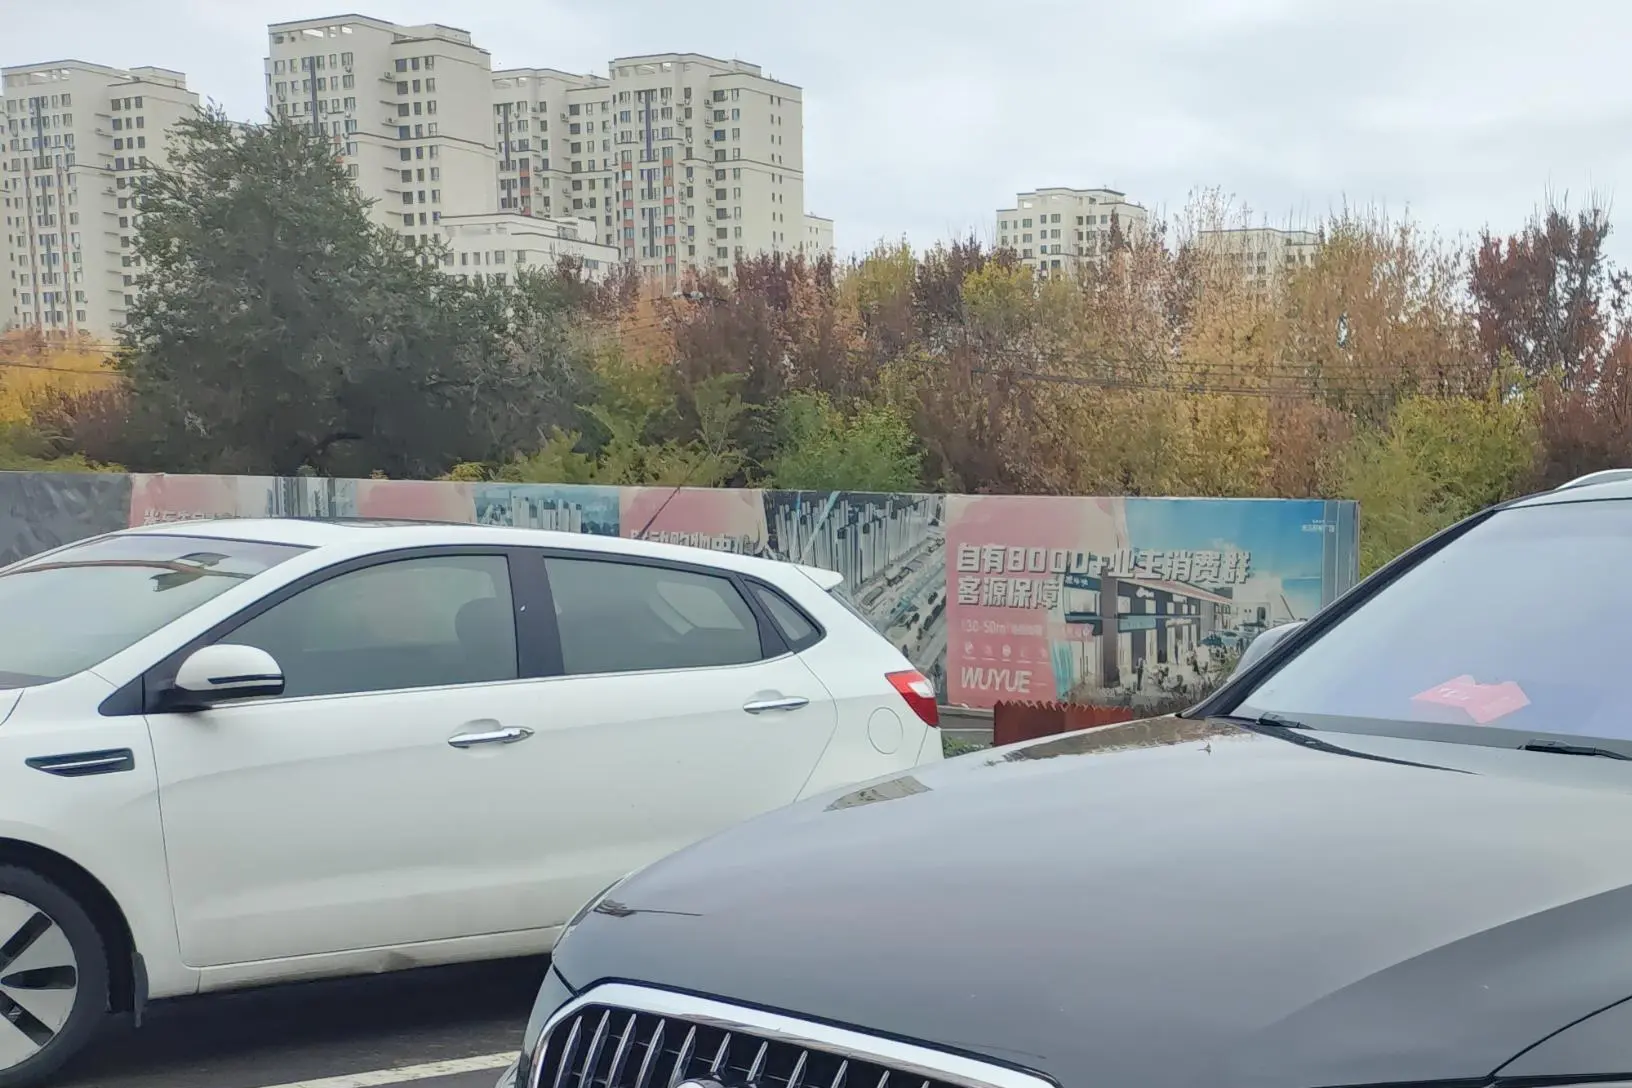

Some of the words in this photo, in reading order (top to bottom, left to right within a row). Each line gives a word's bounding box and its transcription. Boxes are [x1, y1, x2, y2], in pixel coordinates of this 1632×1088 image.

[958, 576, 1060, 610] 客源保障
[961, 667, 1033, 694] WUYUE
